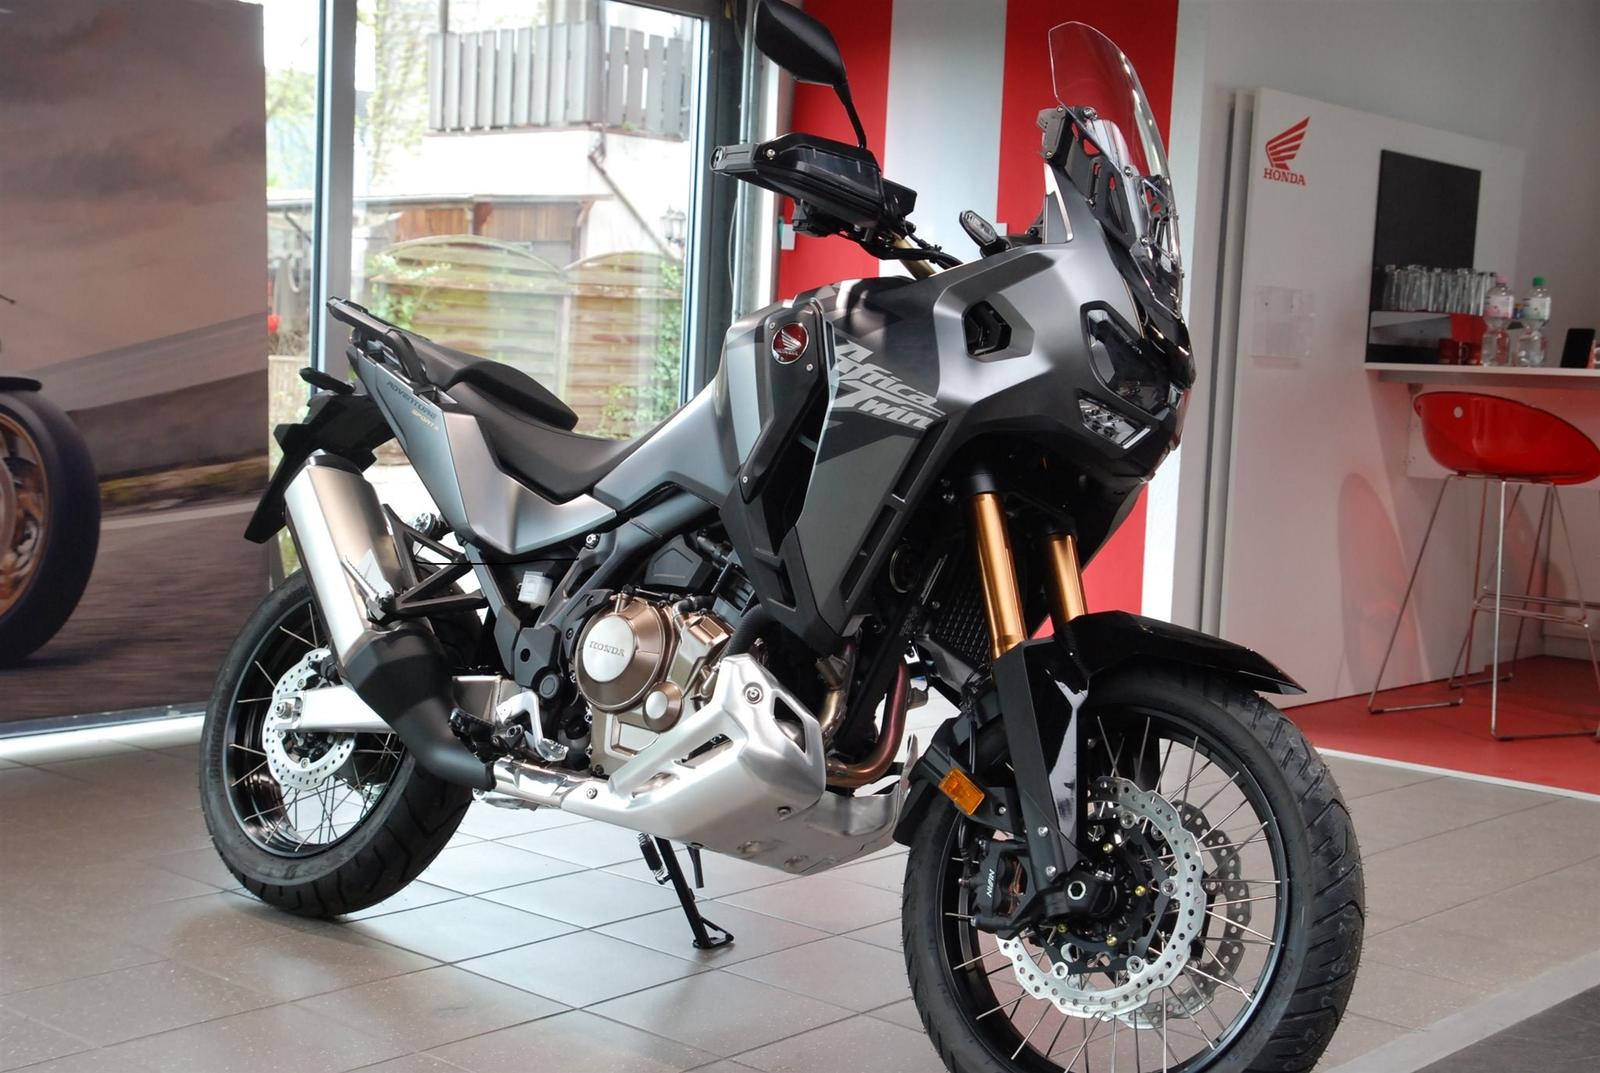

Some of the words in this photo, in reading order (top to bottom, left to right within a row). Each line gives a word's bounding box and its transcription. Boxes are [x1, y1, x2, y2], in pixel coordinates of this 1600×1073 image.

[1263, 167, 1306, 186] HONDA
[834, 339, 939, 410] Africa
[386, 380, 437, 419] ADVENTURE
[833, 380, 941, 430] Twin
[589, 640, 625, 657] HONDA
